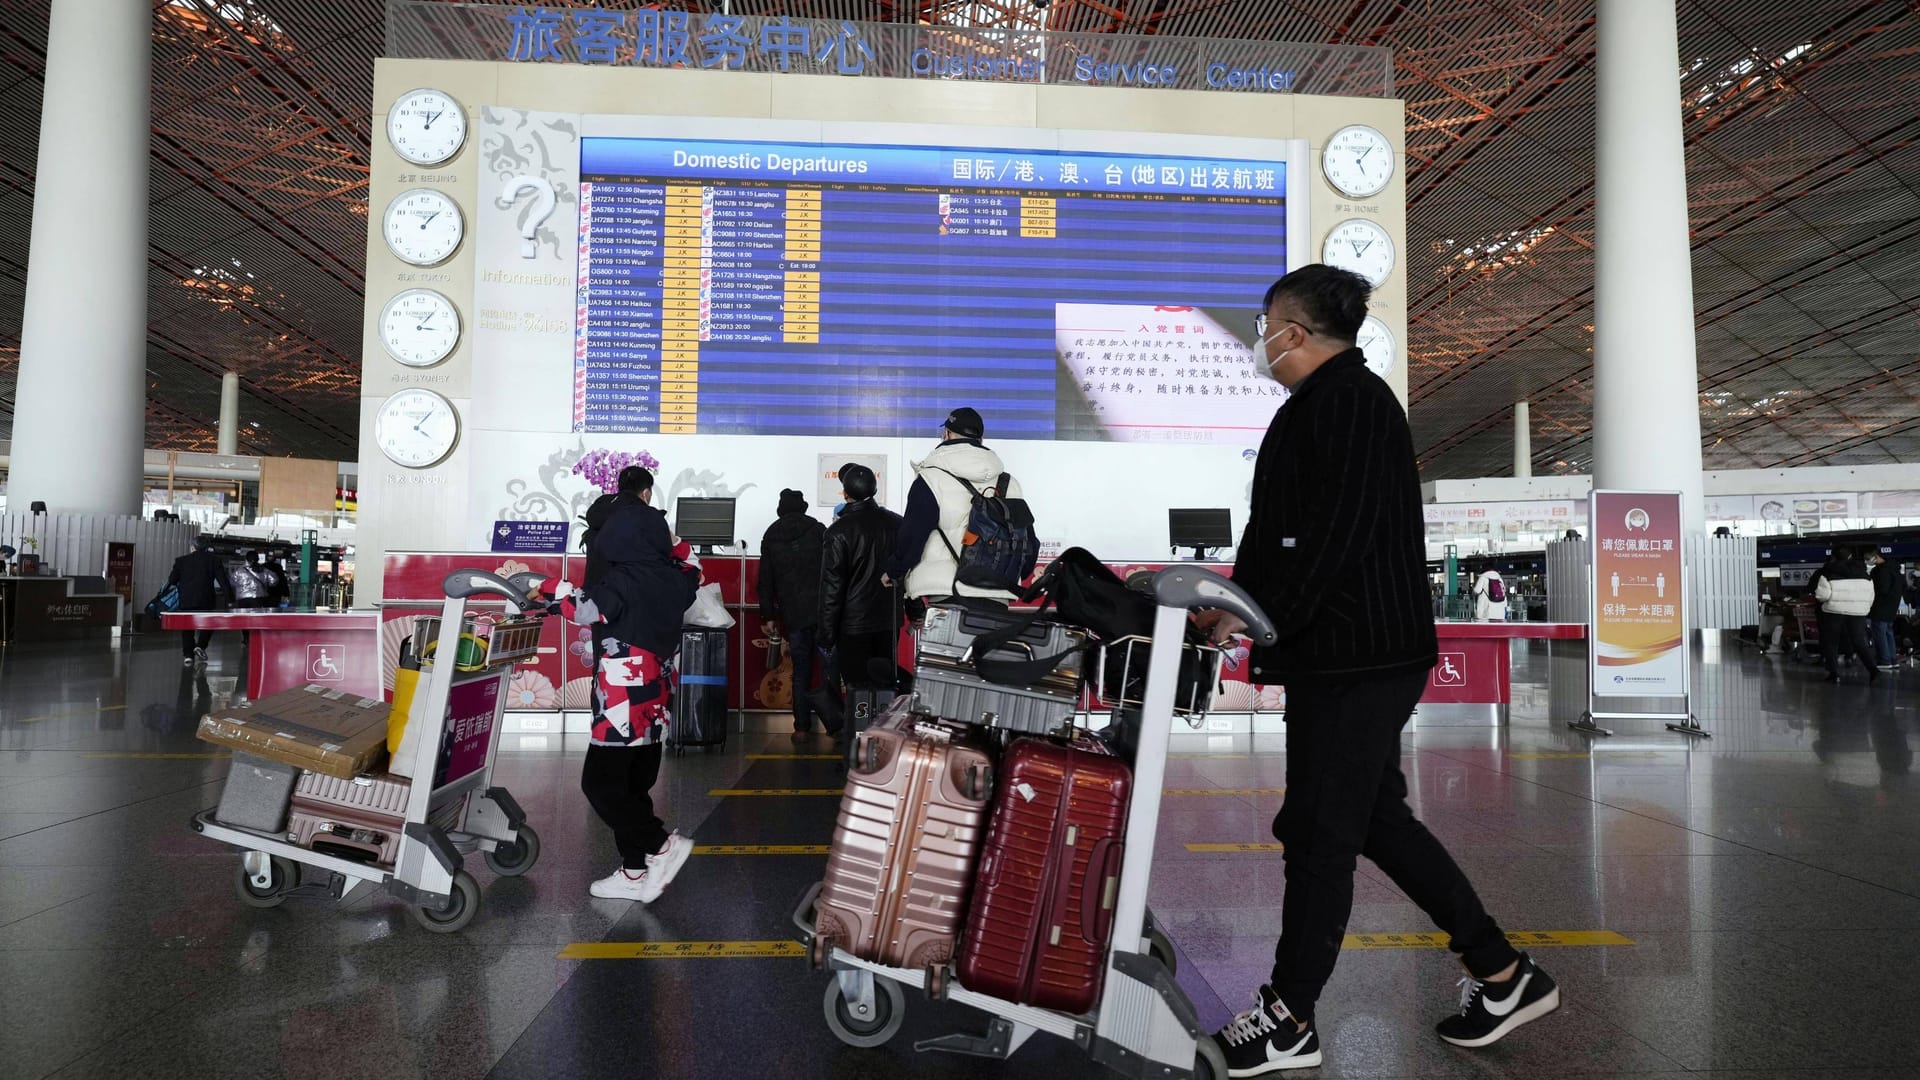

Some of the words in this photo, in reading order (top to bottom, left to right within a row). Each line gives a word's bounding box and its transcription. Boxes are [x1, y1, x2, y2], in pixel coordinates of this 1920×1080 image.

[506, 8, 875, 76] 旅客服务中心
[910, 47, 1046, 79] Customer
[1074, 55, 1178, 87] Service
[1206, 62, 1297, 92] Center
[672, 149, 762, 172] Domestic
[766, 152, 870, 175] Departures
[421, 174, 457, 184] BEIJING
[633, 208, 659, 216] Kunming
[1354, 205, 1379, 213] ROME
[420, 273, 451, 282] TOKYO
[481, 268, 571, 287] Information
[629, 343, 655, 351] Kunming
[409, 474, 447, 485] LONDON
[1601, 538, 1673, 551] 请您佩戴口罩
[1602, 603, 1675, 617] 保持一米距离
[680, 950, 711, 958] keep
